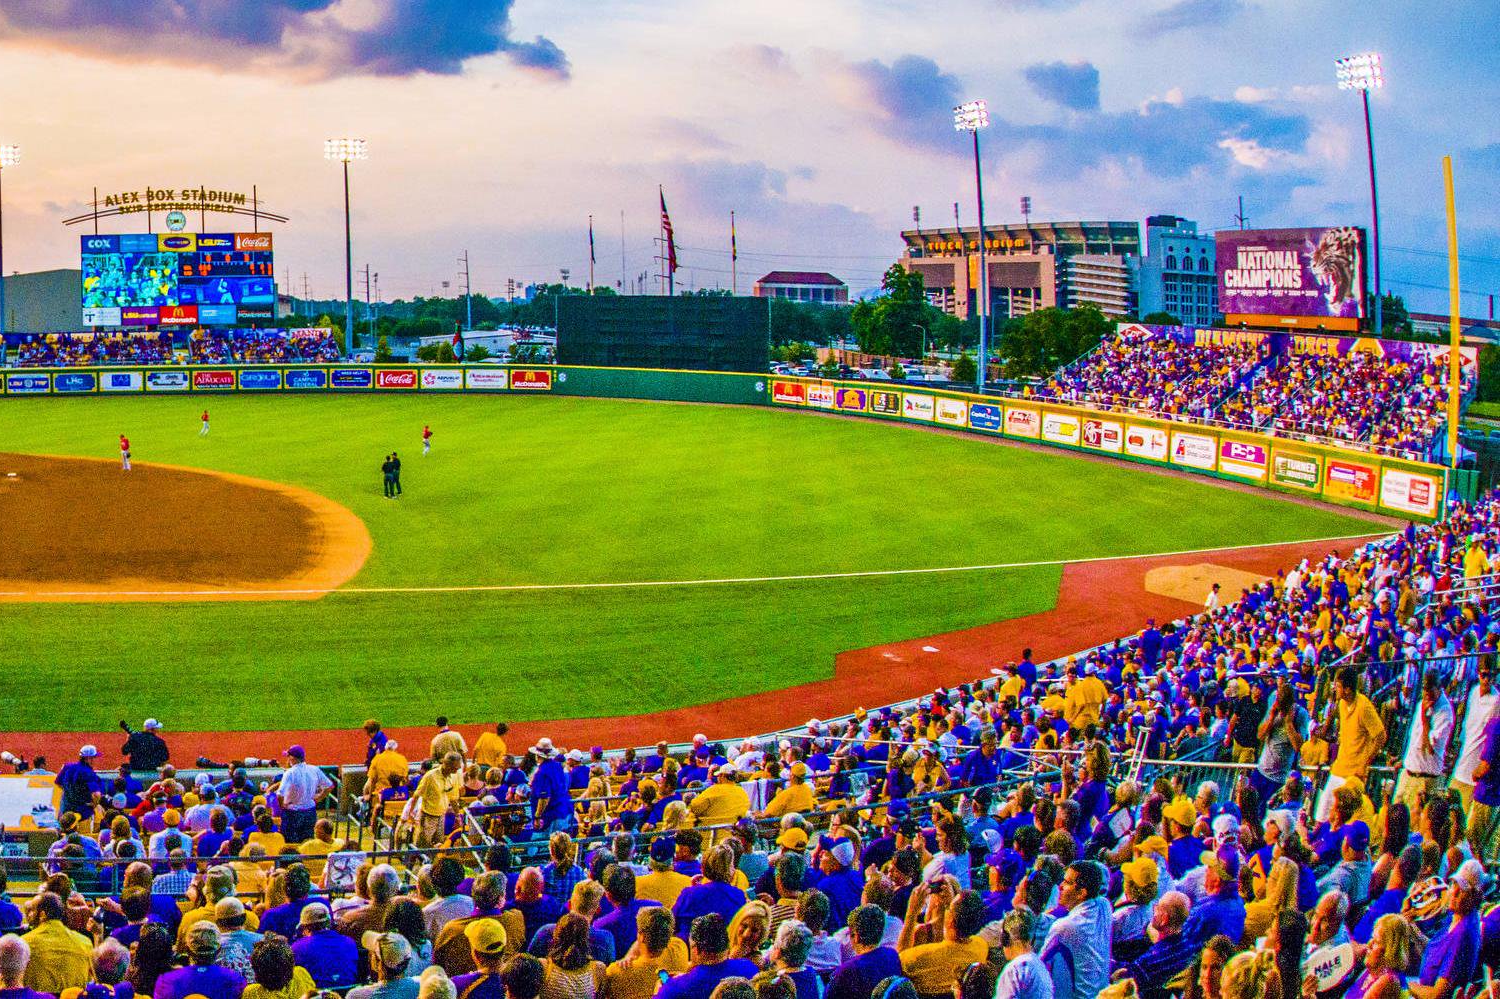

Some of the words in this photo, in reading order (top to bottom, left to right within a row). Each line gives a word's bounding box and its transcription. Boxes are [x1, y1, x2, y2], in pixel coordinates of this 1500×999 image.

[105, 192, 139, 206] ALEX
[146, 190, 174, 201] BOX
[182, 190, 245, 205] STADIUM
[119, 206, 142, 214] SKIP
[88, 239, 110, 248] COX
[969, 239, 1025, 249] SADIUM
[1238, 251, 1301, 269] NATIONAL
[1225, 269, 1302, 288] CHAMPIONS
